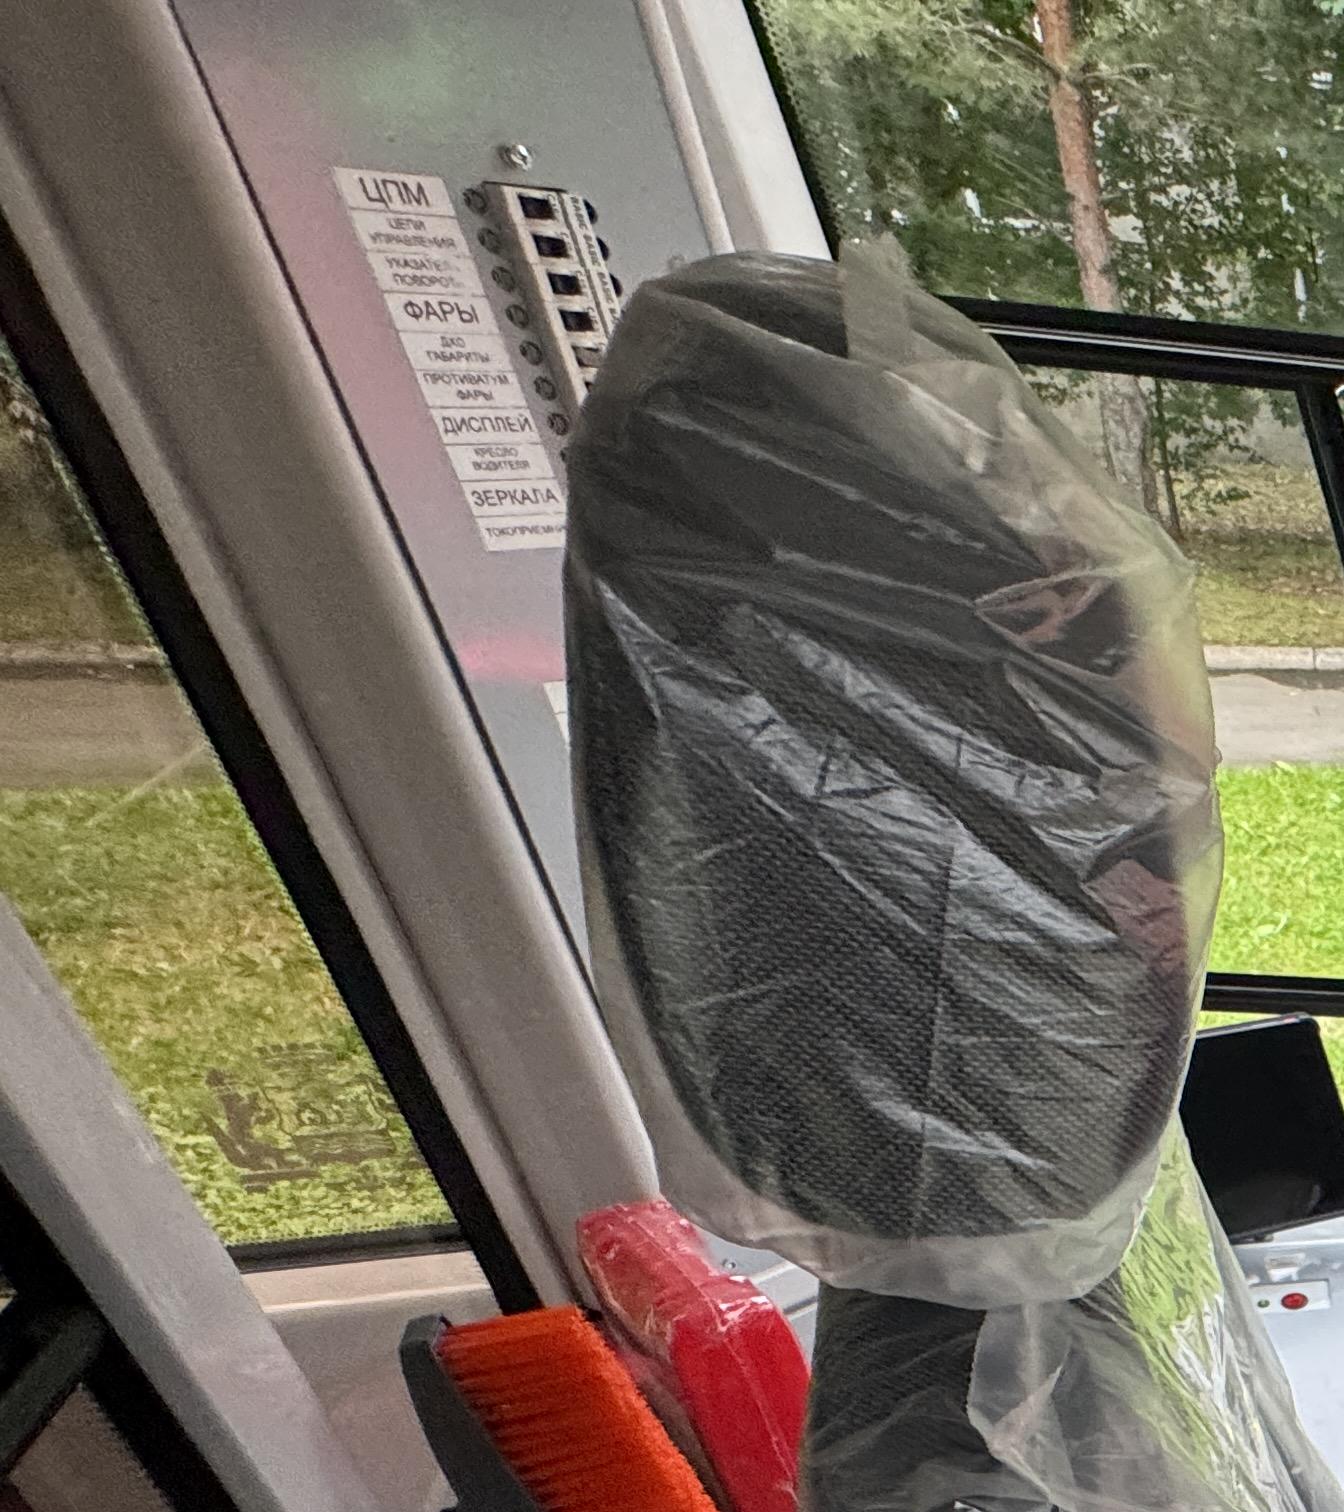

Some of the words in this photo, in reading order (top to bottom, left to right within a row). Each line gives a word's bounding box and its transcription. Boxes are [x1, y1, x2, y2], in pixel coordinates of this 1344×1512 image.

[359, 177, 431, 207] ЦПМ
[388, 217, 426, 231] ЦЕПИ
[369, 232, 456, 249] УПРАВЛЕНИЯ
[404, 301, 480, 324] ФАРЫ
[427, 350, 490, 362] ГАБАРИТЫ
[456, 389, 495, 401] ФАРЫ
[441, 412, 532, 436] ДИСПЛЕЙ
[475, 447, 519, 458] КРЕСЛО
[473, 459, 530, 471] ВОДИТЕЛЯ
[471, 489, 559, 507] ЗЕРКАЛА
